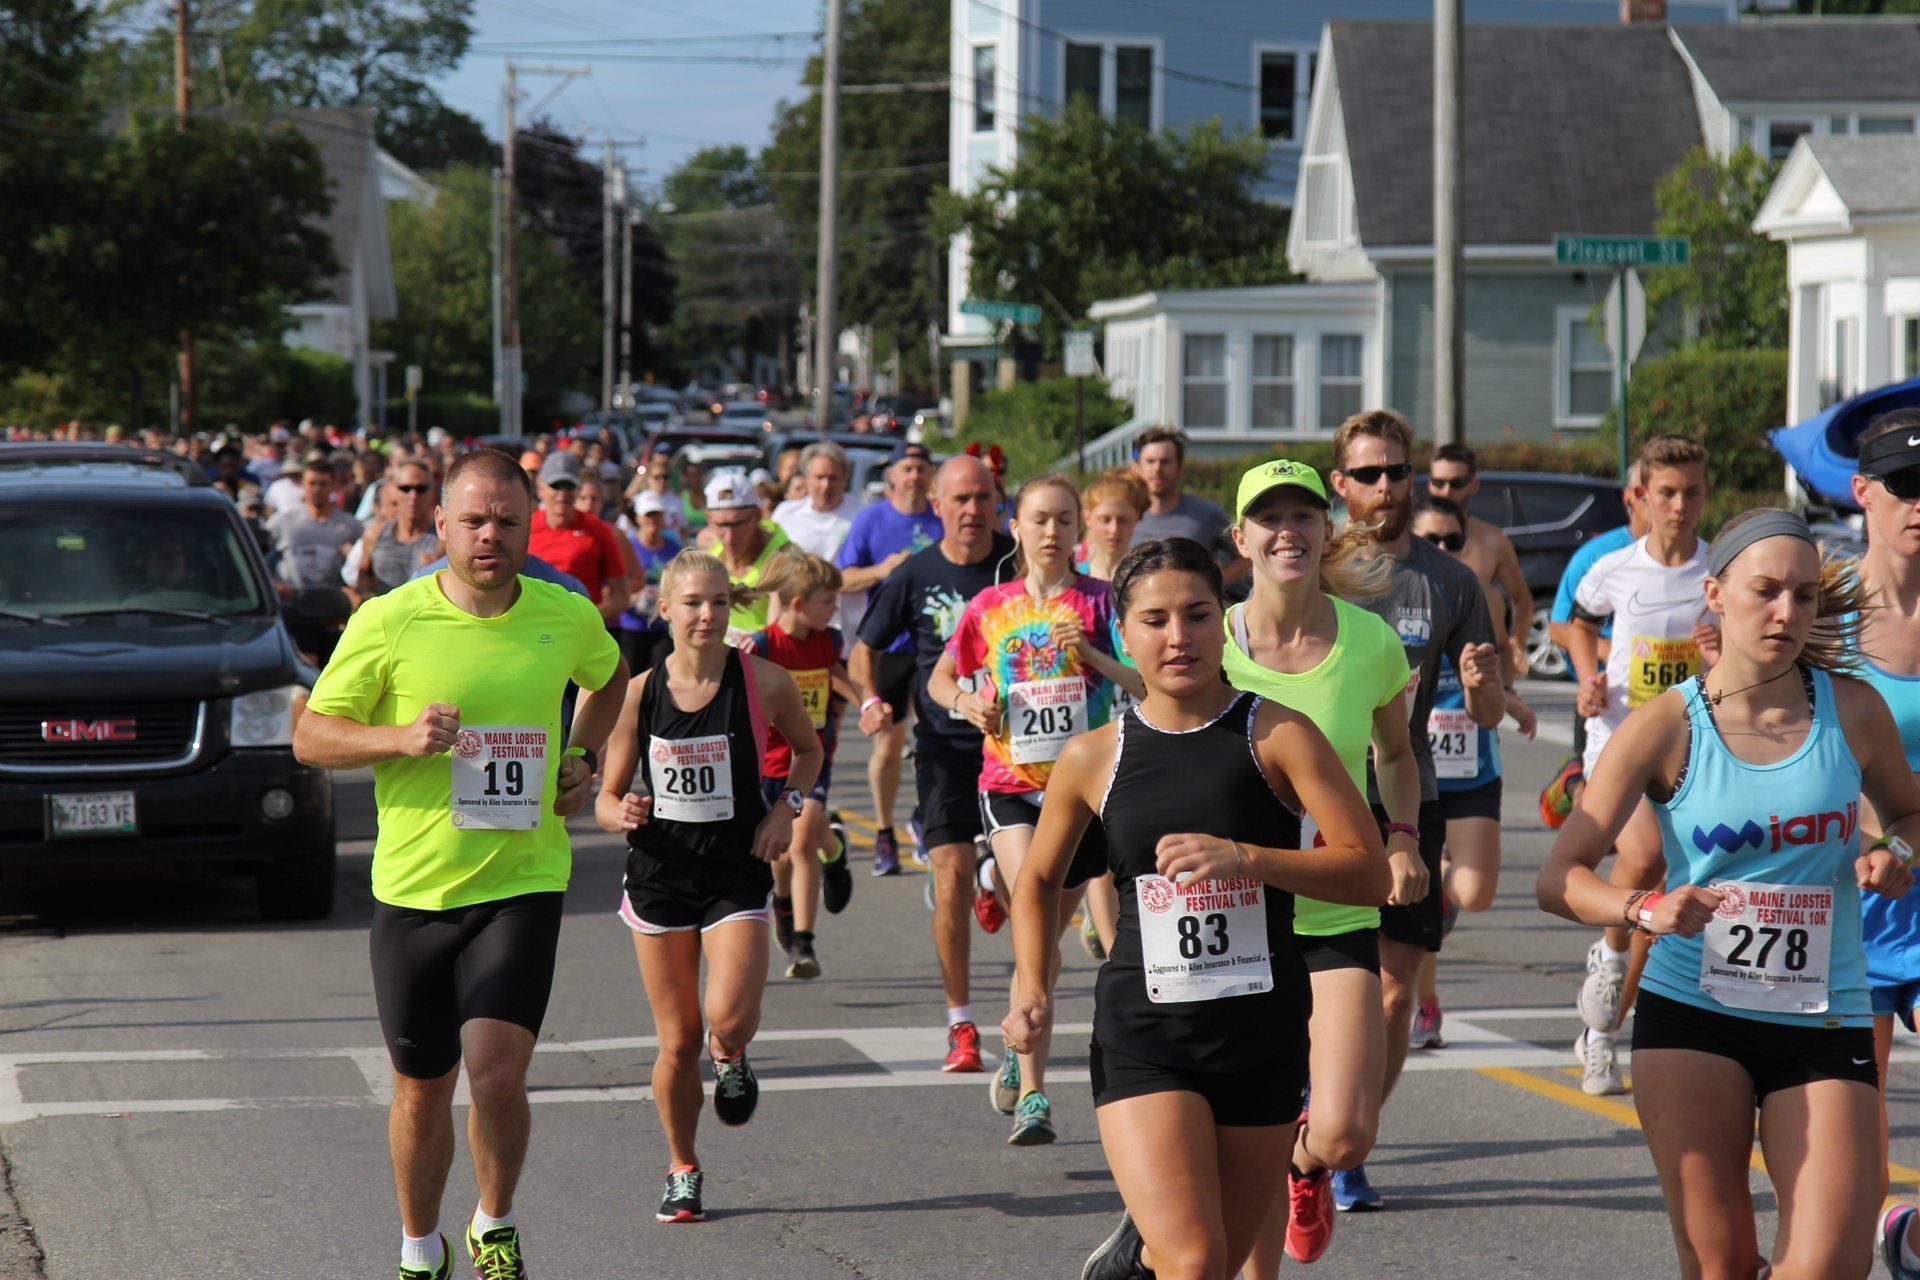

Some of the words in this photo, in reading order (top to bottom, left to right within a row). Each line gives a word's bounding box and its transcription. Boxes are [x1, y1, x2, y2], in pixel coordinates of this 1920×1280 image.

[1565, 238, 1644, 262] Pleasant
[1661, 239, 1679, 262] St
[1643, 662, 1688, 687] 568
[1031, 685, 1053, 696] MAINE
[1055, 682, 1084, 693] LOBSTER
[1037, 695, 1068, 706] FESTIVAL
[41, 719, 136, 741] GMC
[1022, 705, 1073, 736] 203
[484, 732, 513, 745] MAINE
[515, 733, 547, 745] LOBSTER
[670, 744, 695, 755] MAINE
[697, 740, 728, 753] LOBSTER
[492, 746, 529, 759] FESTIVAL
[531, 746, 544, 759] 10K
[677, 755, 710, 766] FESTIVAL
[712, 752, 726, 763] 10K
[484, 761, 524, 796] 19
[664, 765, 715, 795] 280
[482, 798, 488, 807] by
[1769, 800, 1857, 853] janji
[1216, 876, 1261, 893] LOBSTER
[1186, 894, 1236, 912] FESTIVAL
[1239, 890, 1259, 907] 10K
[1749, 891, 1786, 908] MAINE
[1789, 893, 1832, 909] LOBSTER
[1757, 908, 1806, 925] FESTIVAL
[1809, 910, 1827, 925] 10K
[1177, 913, 1230, 960] 83
[1726, 924, 1809, 971] 278
[1180, 964, 1187, 974] by
[1188, 962, 1202, 971] Allen
[1204, 960, 1230, 970] Insurance
[1237, 953, 1261, 965] Financial
[1710, 965, 1739, 978] Sponsored
[1739, 968, 1747, 980] by
